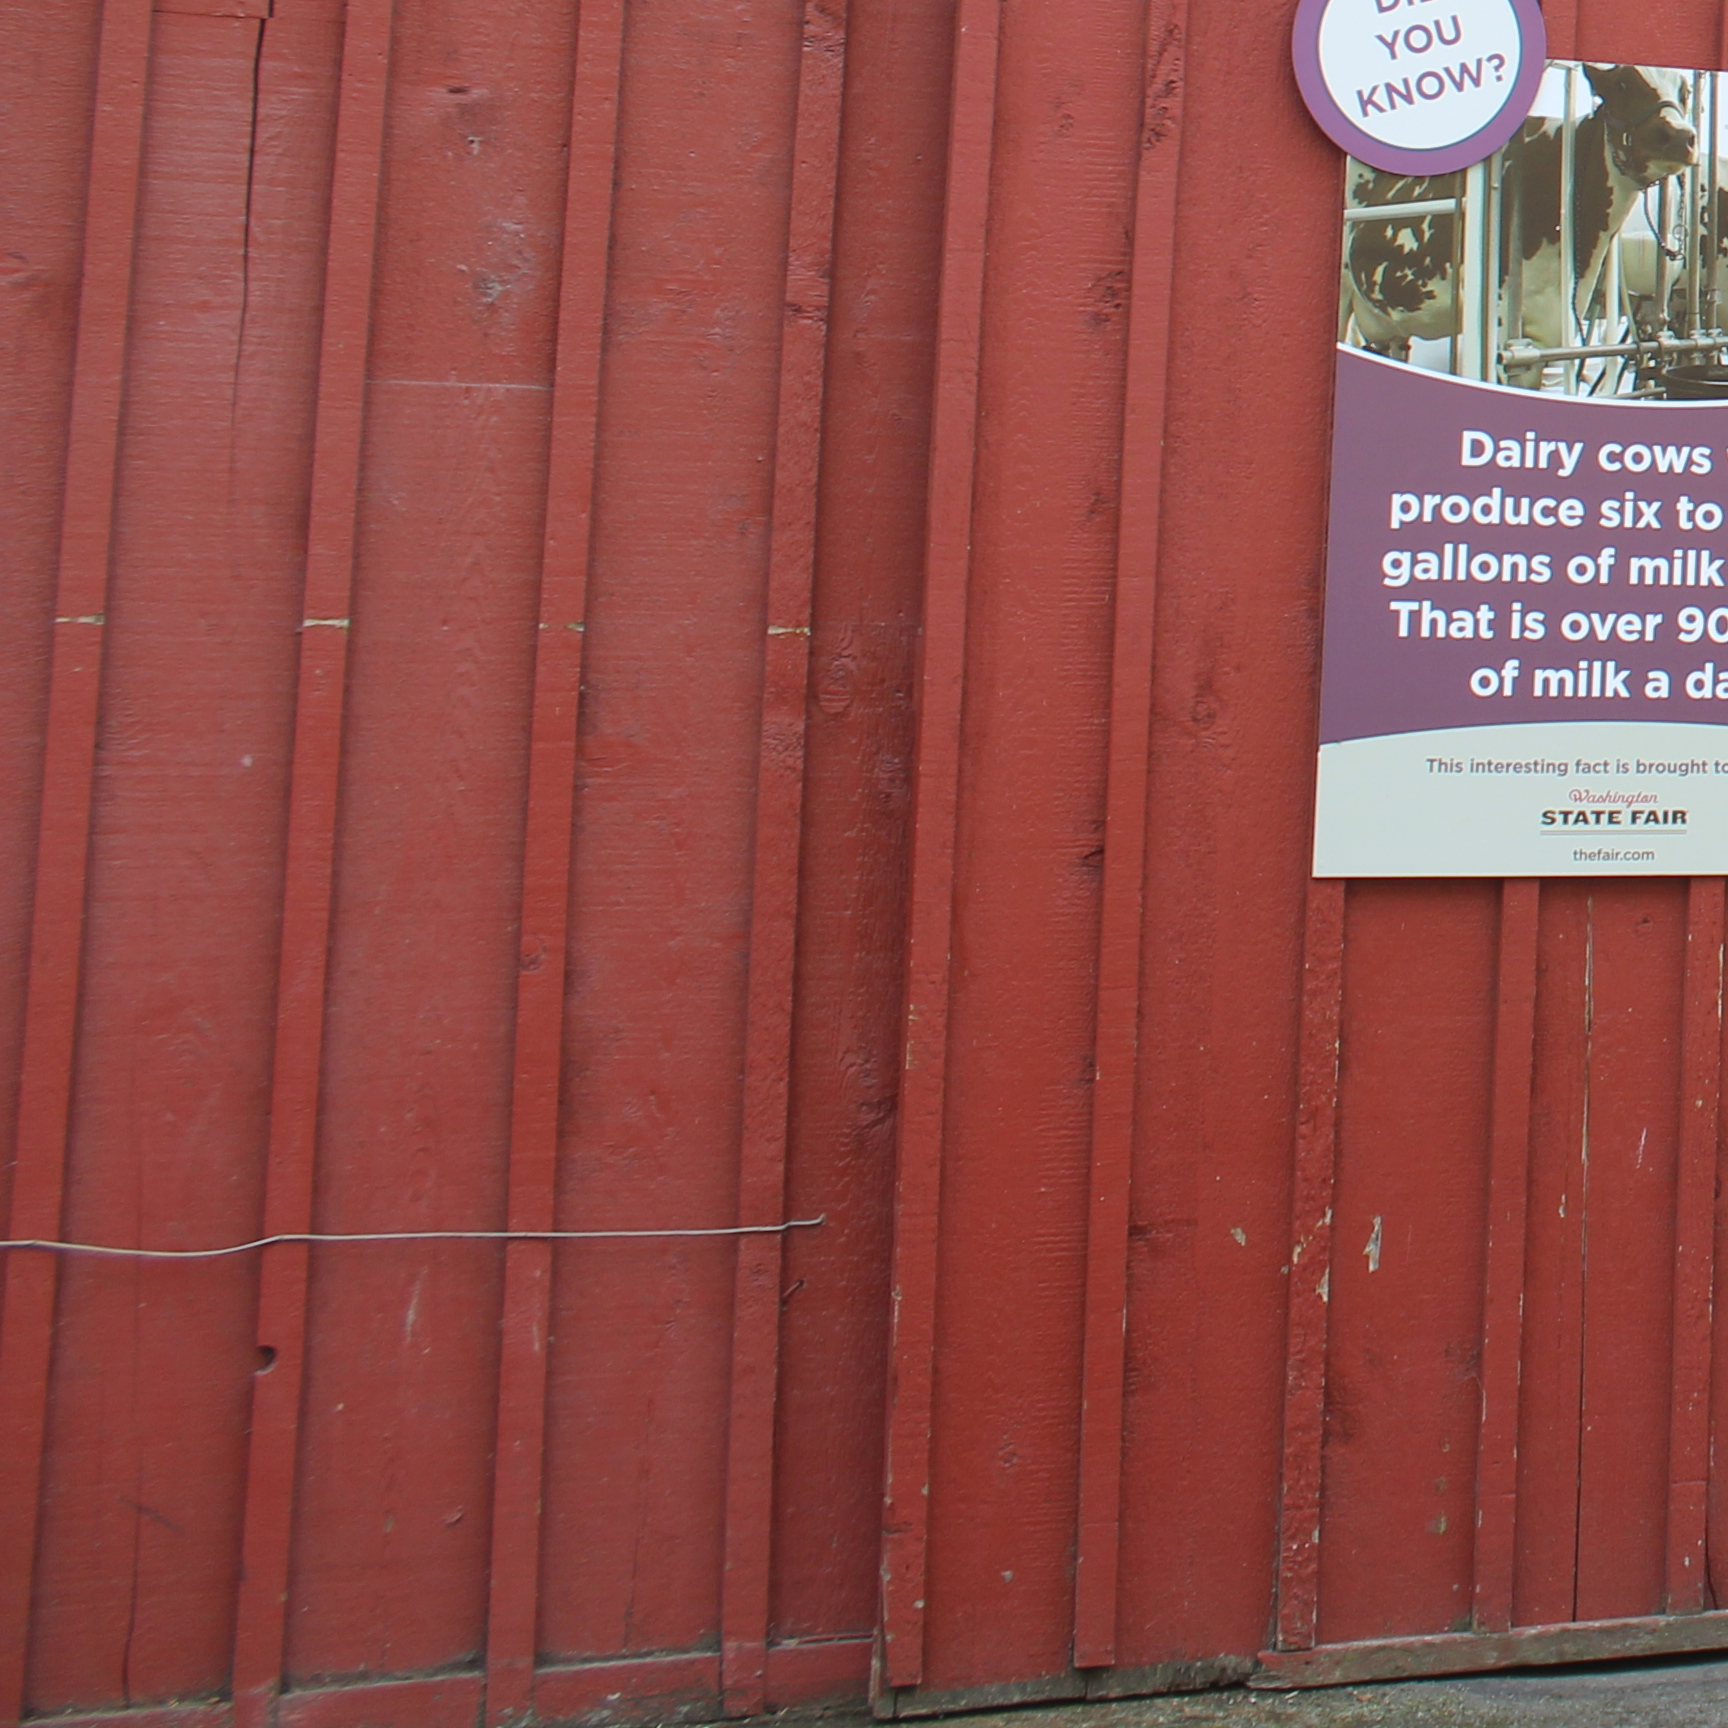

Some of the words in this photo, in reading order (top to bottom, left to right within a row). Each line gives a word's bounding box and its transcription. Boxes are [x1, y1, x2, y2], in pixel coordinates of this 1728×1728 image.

[1375, 15, 1461, 60] YOU
[1356, 54, 1505, 117] KNOW?
[1462, 431, 1583, 476] Dairy
[1598, 444, 1711, 474] cows
[1391, 488, 1584, 528] produce
[1600, 490, 1661, 528] six
[1677, 496, 1722, 530] to
[1383, 544, 1551, 586] gallons
[1567, 548, 1615, 583] of
[1630, 550, 1724, 586] milk
[1390, 601, 1494, 638] That
[1511, 603, 1545, 639] is
[1561, 613, 1662, 641] over
[1471, 660, 1519, 696] of
[1534, 661, 1630, 697] milk
[1645, 671, 1669, 698] a
[1426, 758, 1463, 773] This
[1470, 758, 1568, 777] interesting
[1575, 759, 1609, 774] fact
[1616, 759, 1629, 774] is
[1636, 759, 1707, 777] brought
[1542, 810, 1621, 825] STATE
[1631, 810, 1686, 824] FAIR
[1569, 789, 1658, 808] Washington
[1573, 848, 1654, 861] thefair.com
